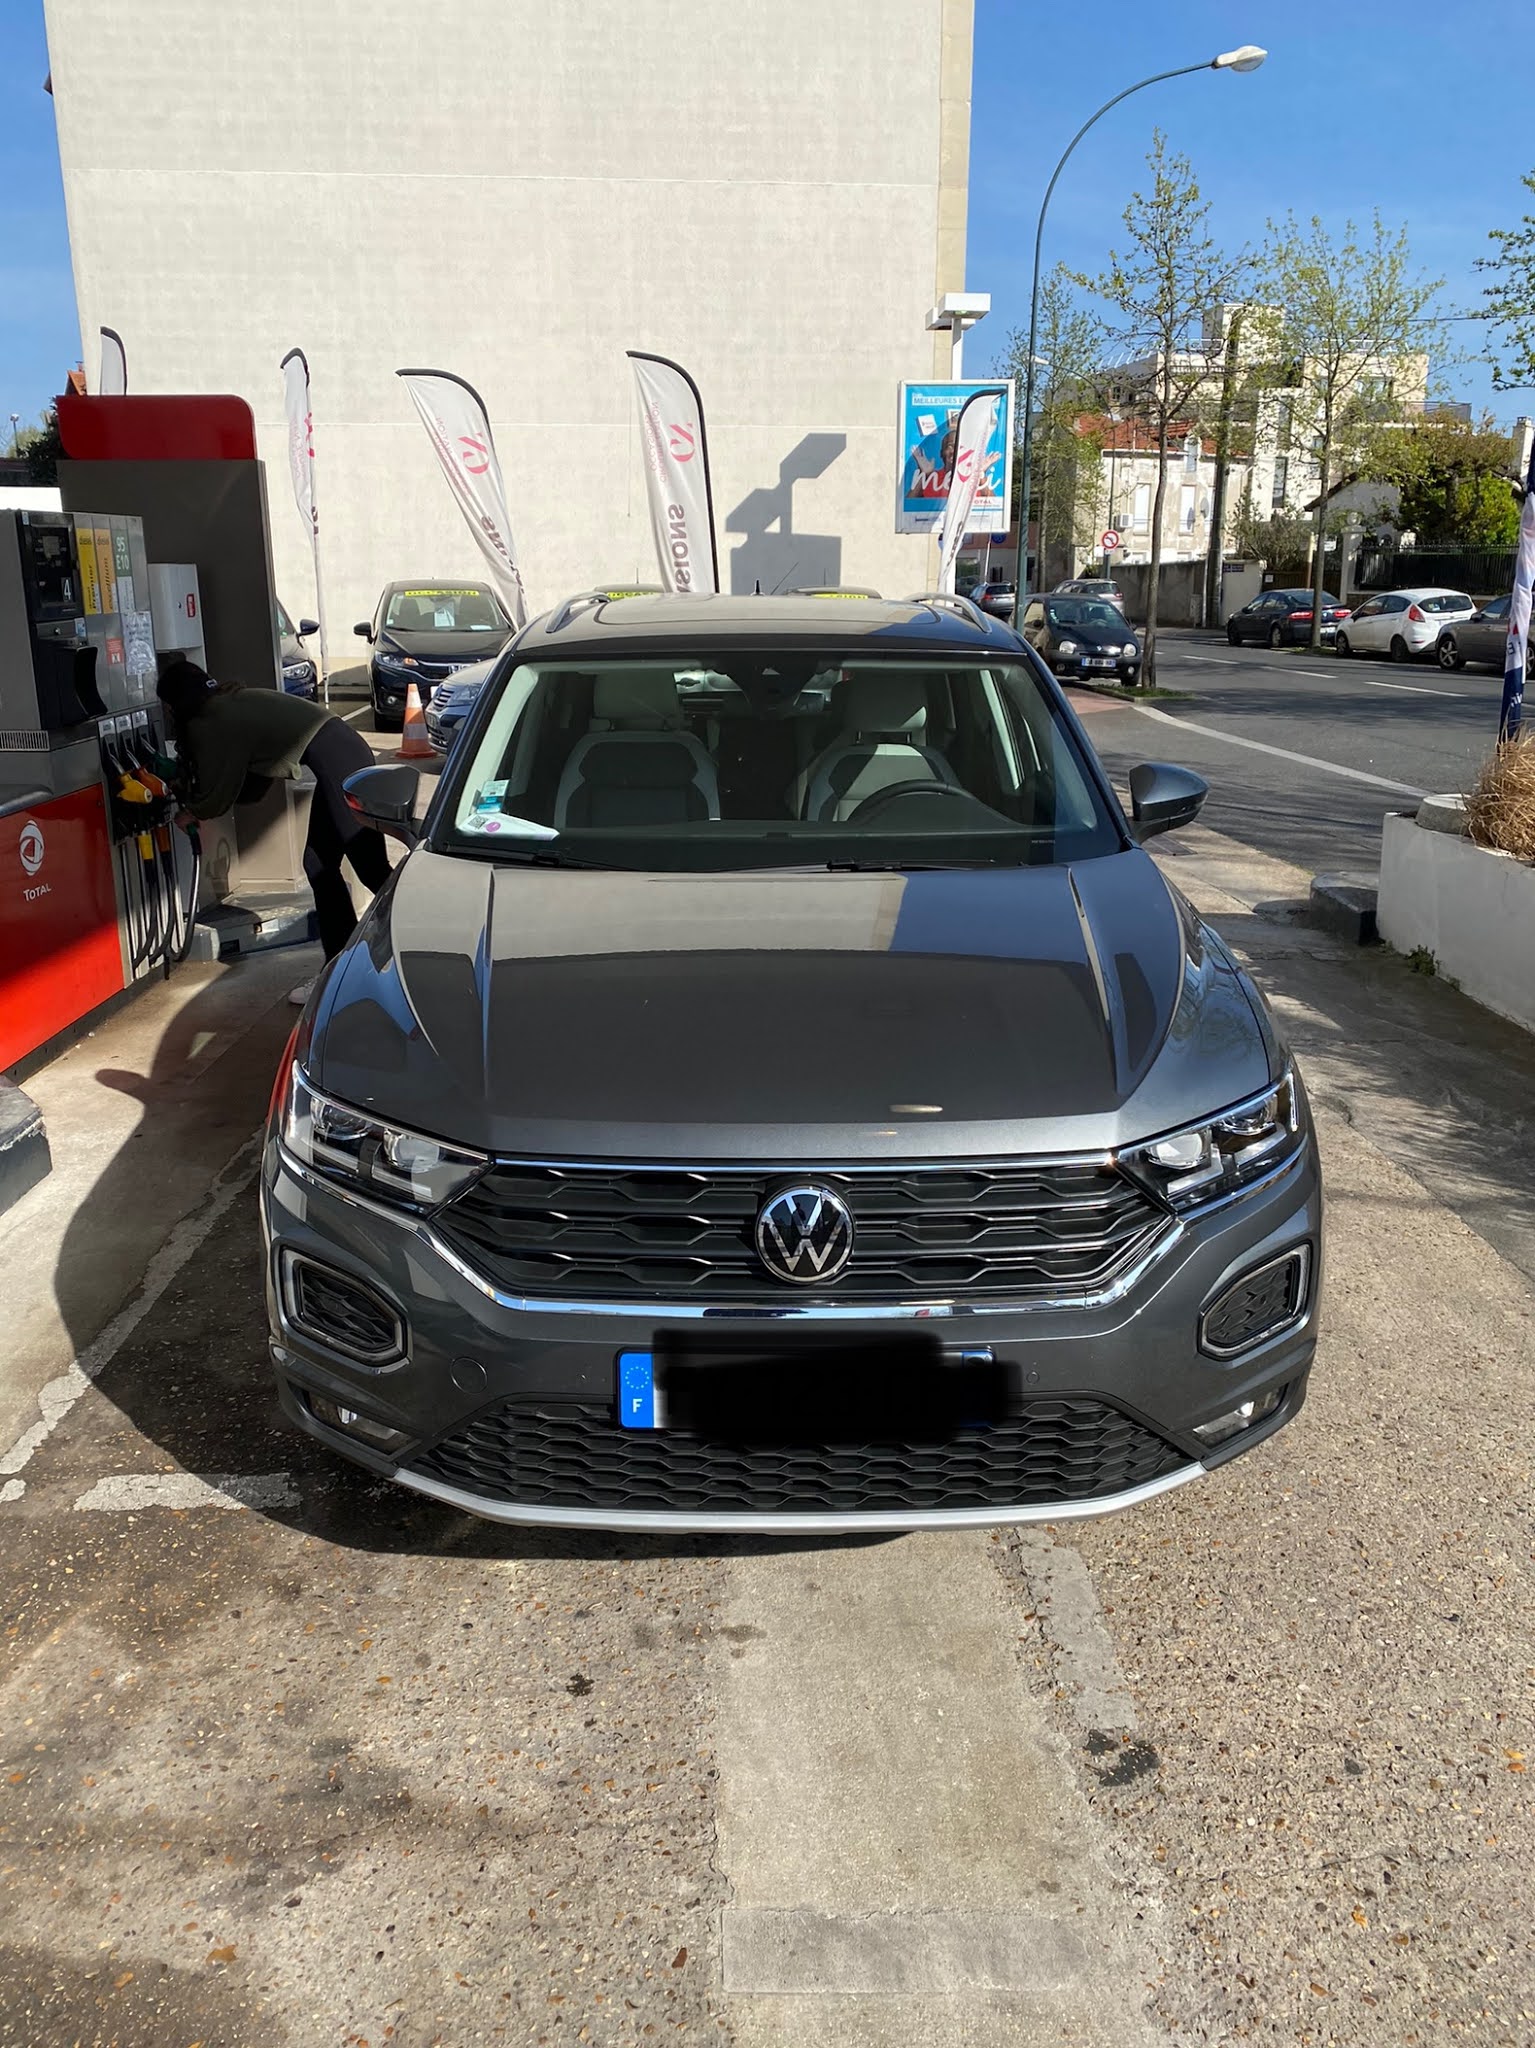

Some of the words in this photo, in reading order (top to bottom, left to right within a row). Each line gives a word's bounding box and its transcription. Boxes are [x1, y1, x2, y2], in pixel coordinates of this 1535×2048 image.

[116, 555, 129, 570] E10
[64, 579, 71, 600] 4
[23, 883, 52, 902] TOTAL
[632, 1398, 643, 1413] F
